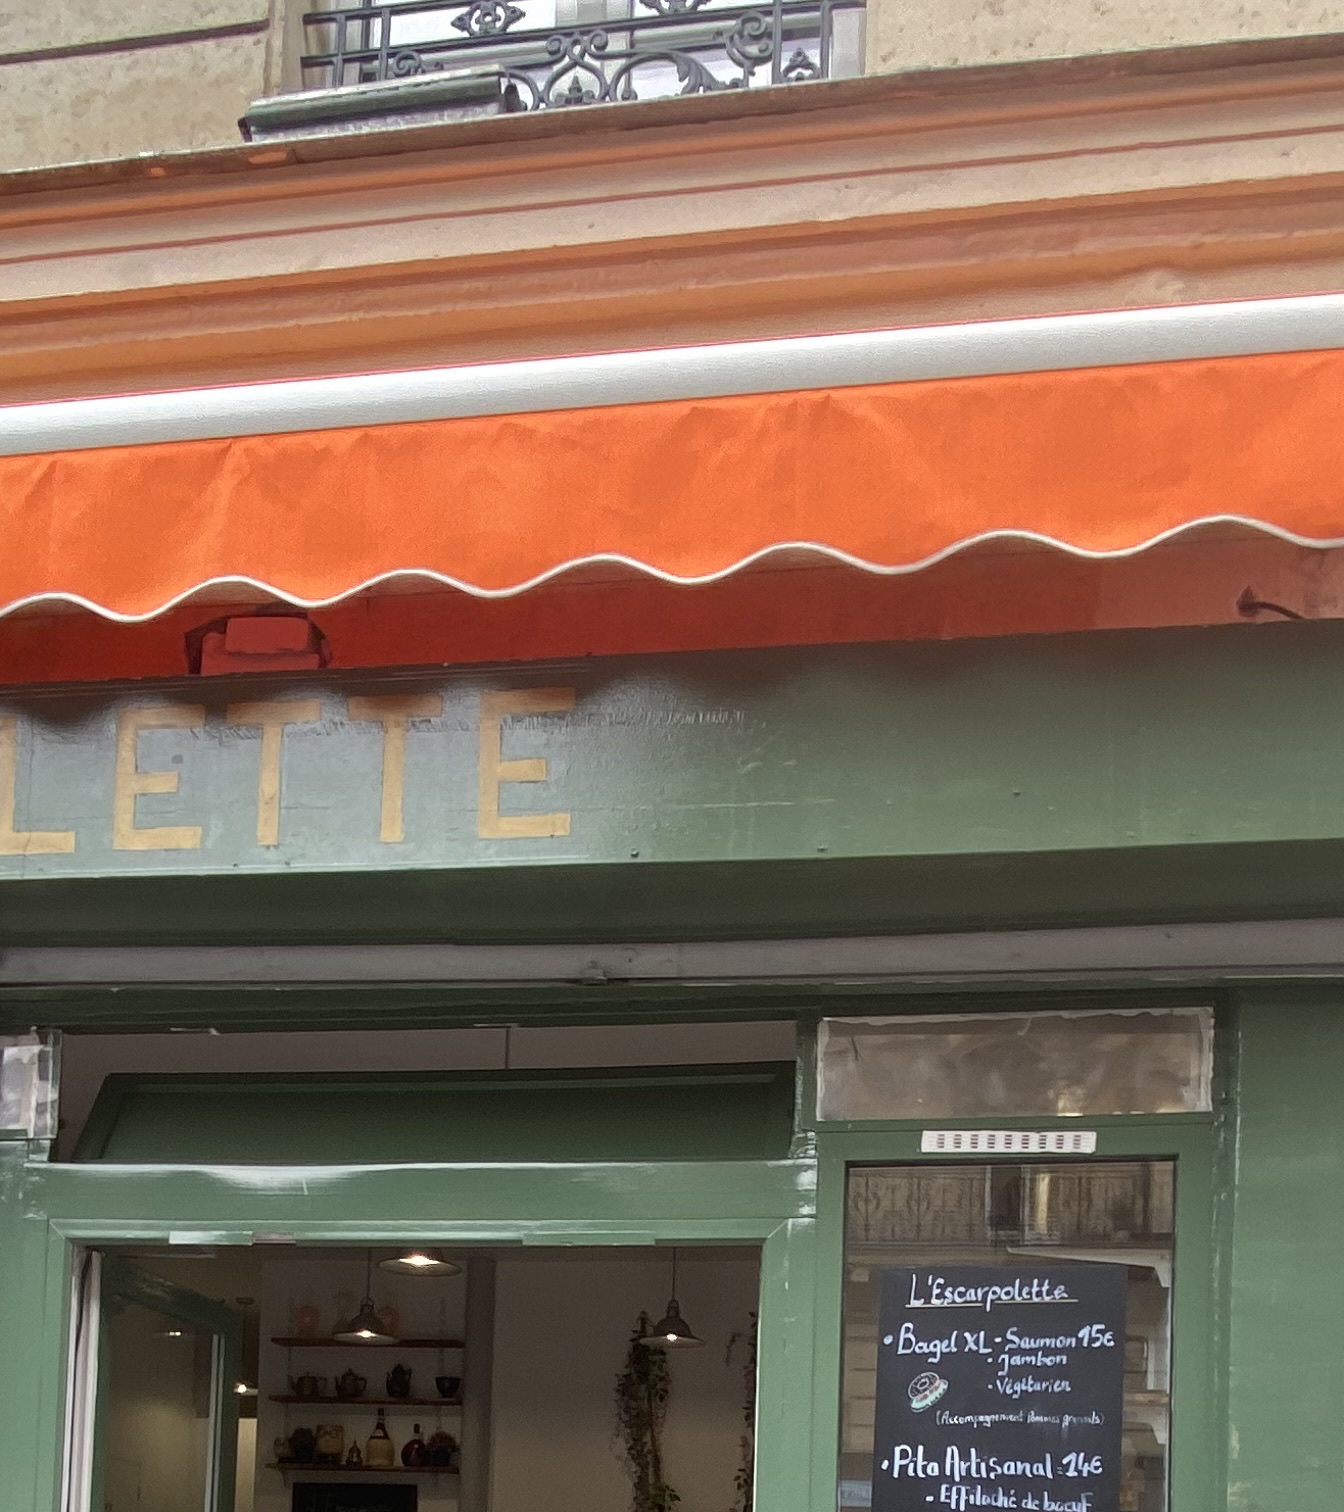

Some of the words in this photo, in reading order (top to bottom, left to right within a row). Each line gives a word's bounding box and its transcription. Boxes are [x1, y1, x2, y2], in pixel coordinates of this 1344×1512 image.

[908, 1273, 1070, 1312] L'Escarpolette
[896, 1321, 958, 1363] Bagel
[963, 1330, 993, 1354] XL
[1005, 1326, 1076, 1352] Saumon
[1077, 1324, 1115, 1349] 15€
[893, 1444, 940, 1479] Pita
[945, 1445, 1053, 1482] Artisanal
[1061, 1451, 1103, 1478] 14€
[1022, 1489, 1040, 1512] de
